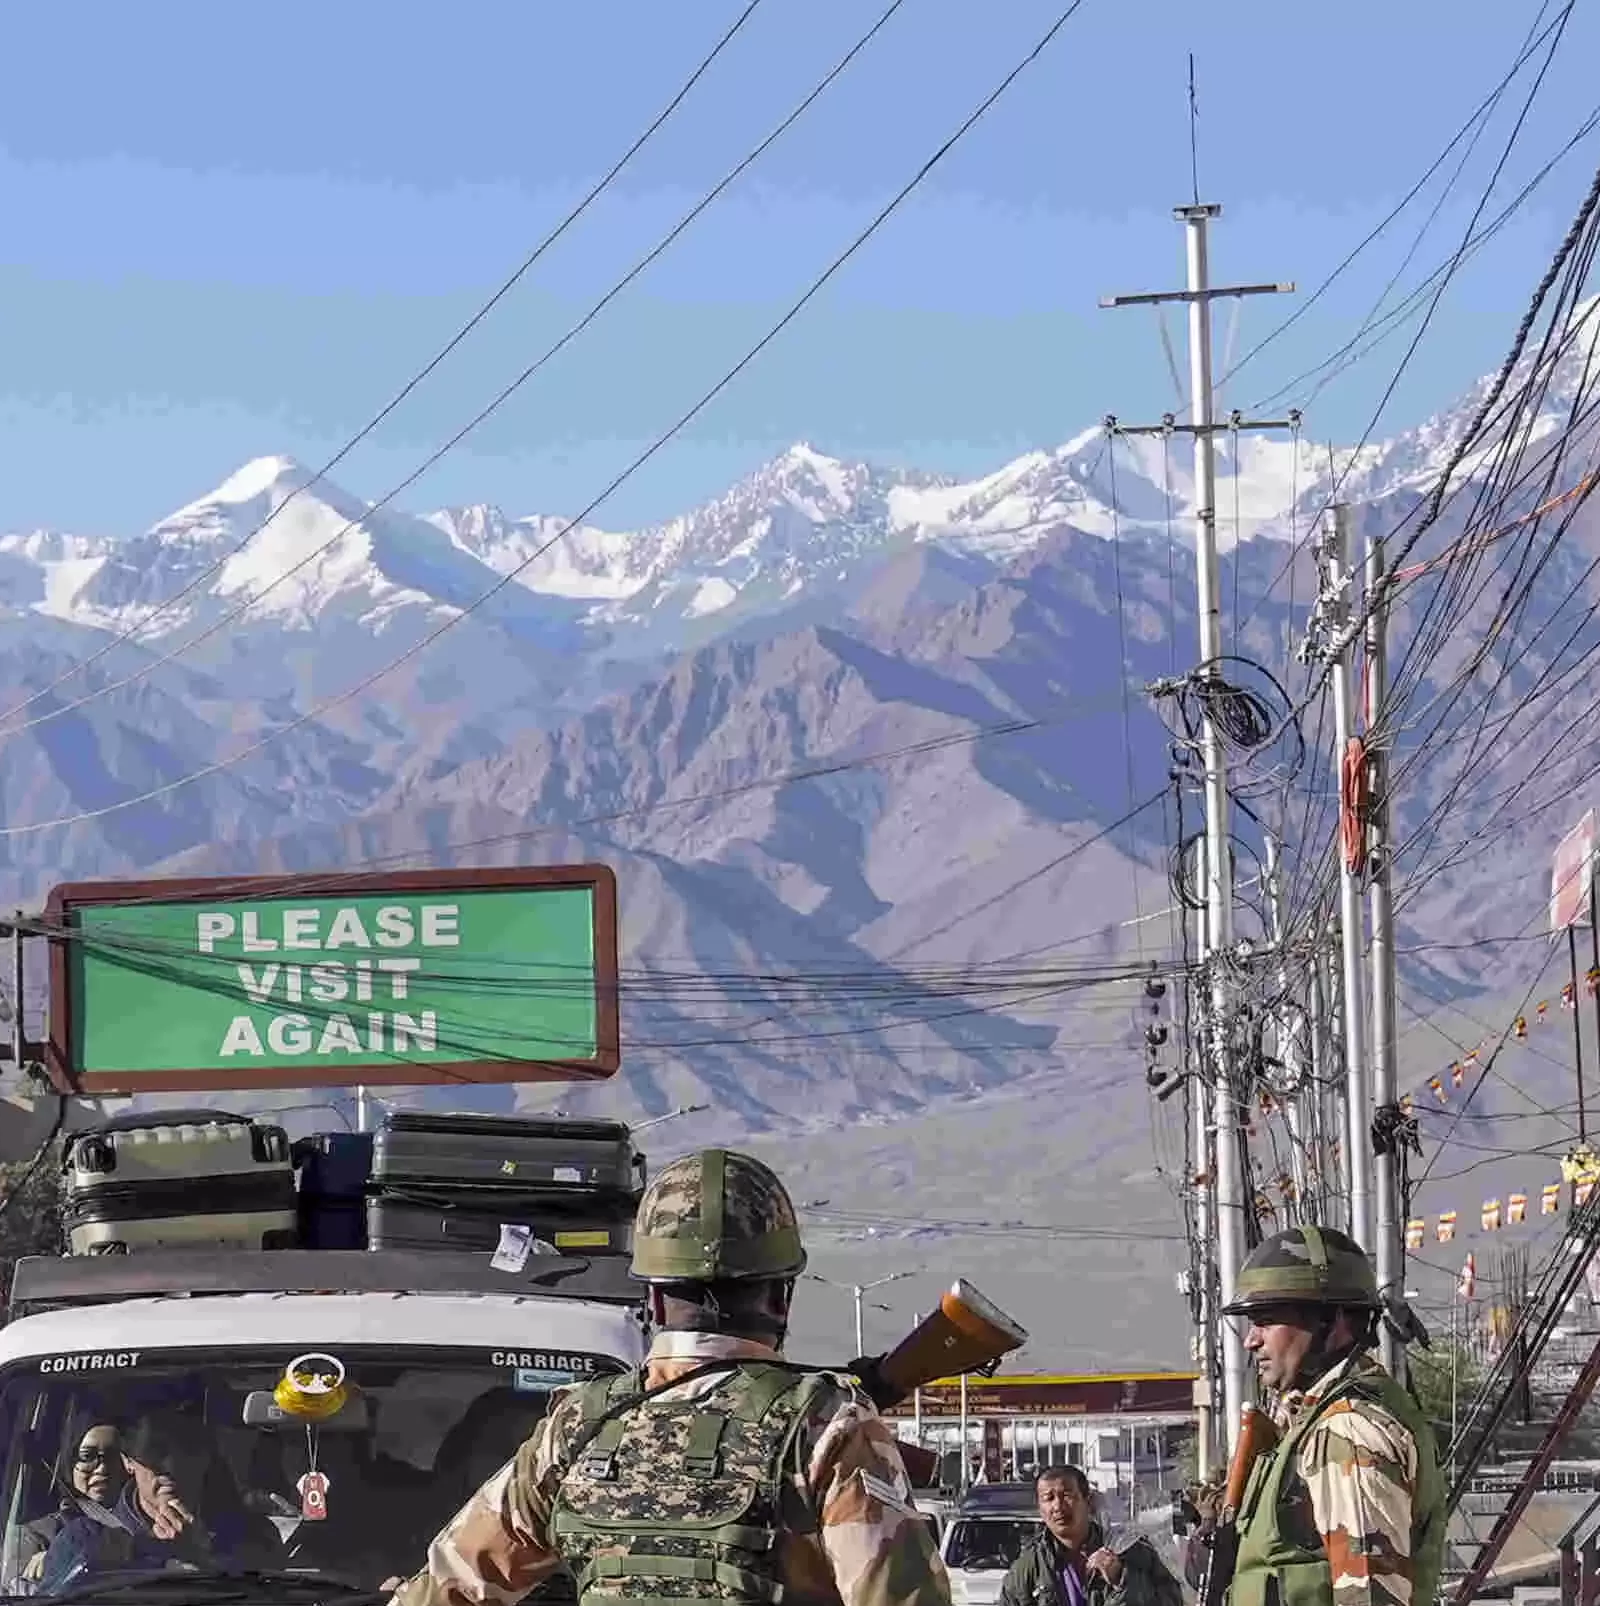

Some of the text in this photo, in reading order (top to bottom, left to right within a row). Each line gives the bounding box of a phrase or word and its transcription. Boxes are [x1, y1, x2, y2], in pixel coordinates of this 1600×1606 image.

[197, 905, 460, 952] PLEASE
[238, 958, 421, 1003] VISIT
[219, 1011, 438, 1057] AGAIN
[40, 1353, 141, 1373] CONTRACT
[491, 1351, 596, 1372] CARRIAGE
